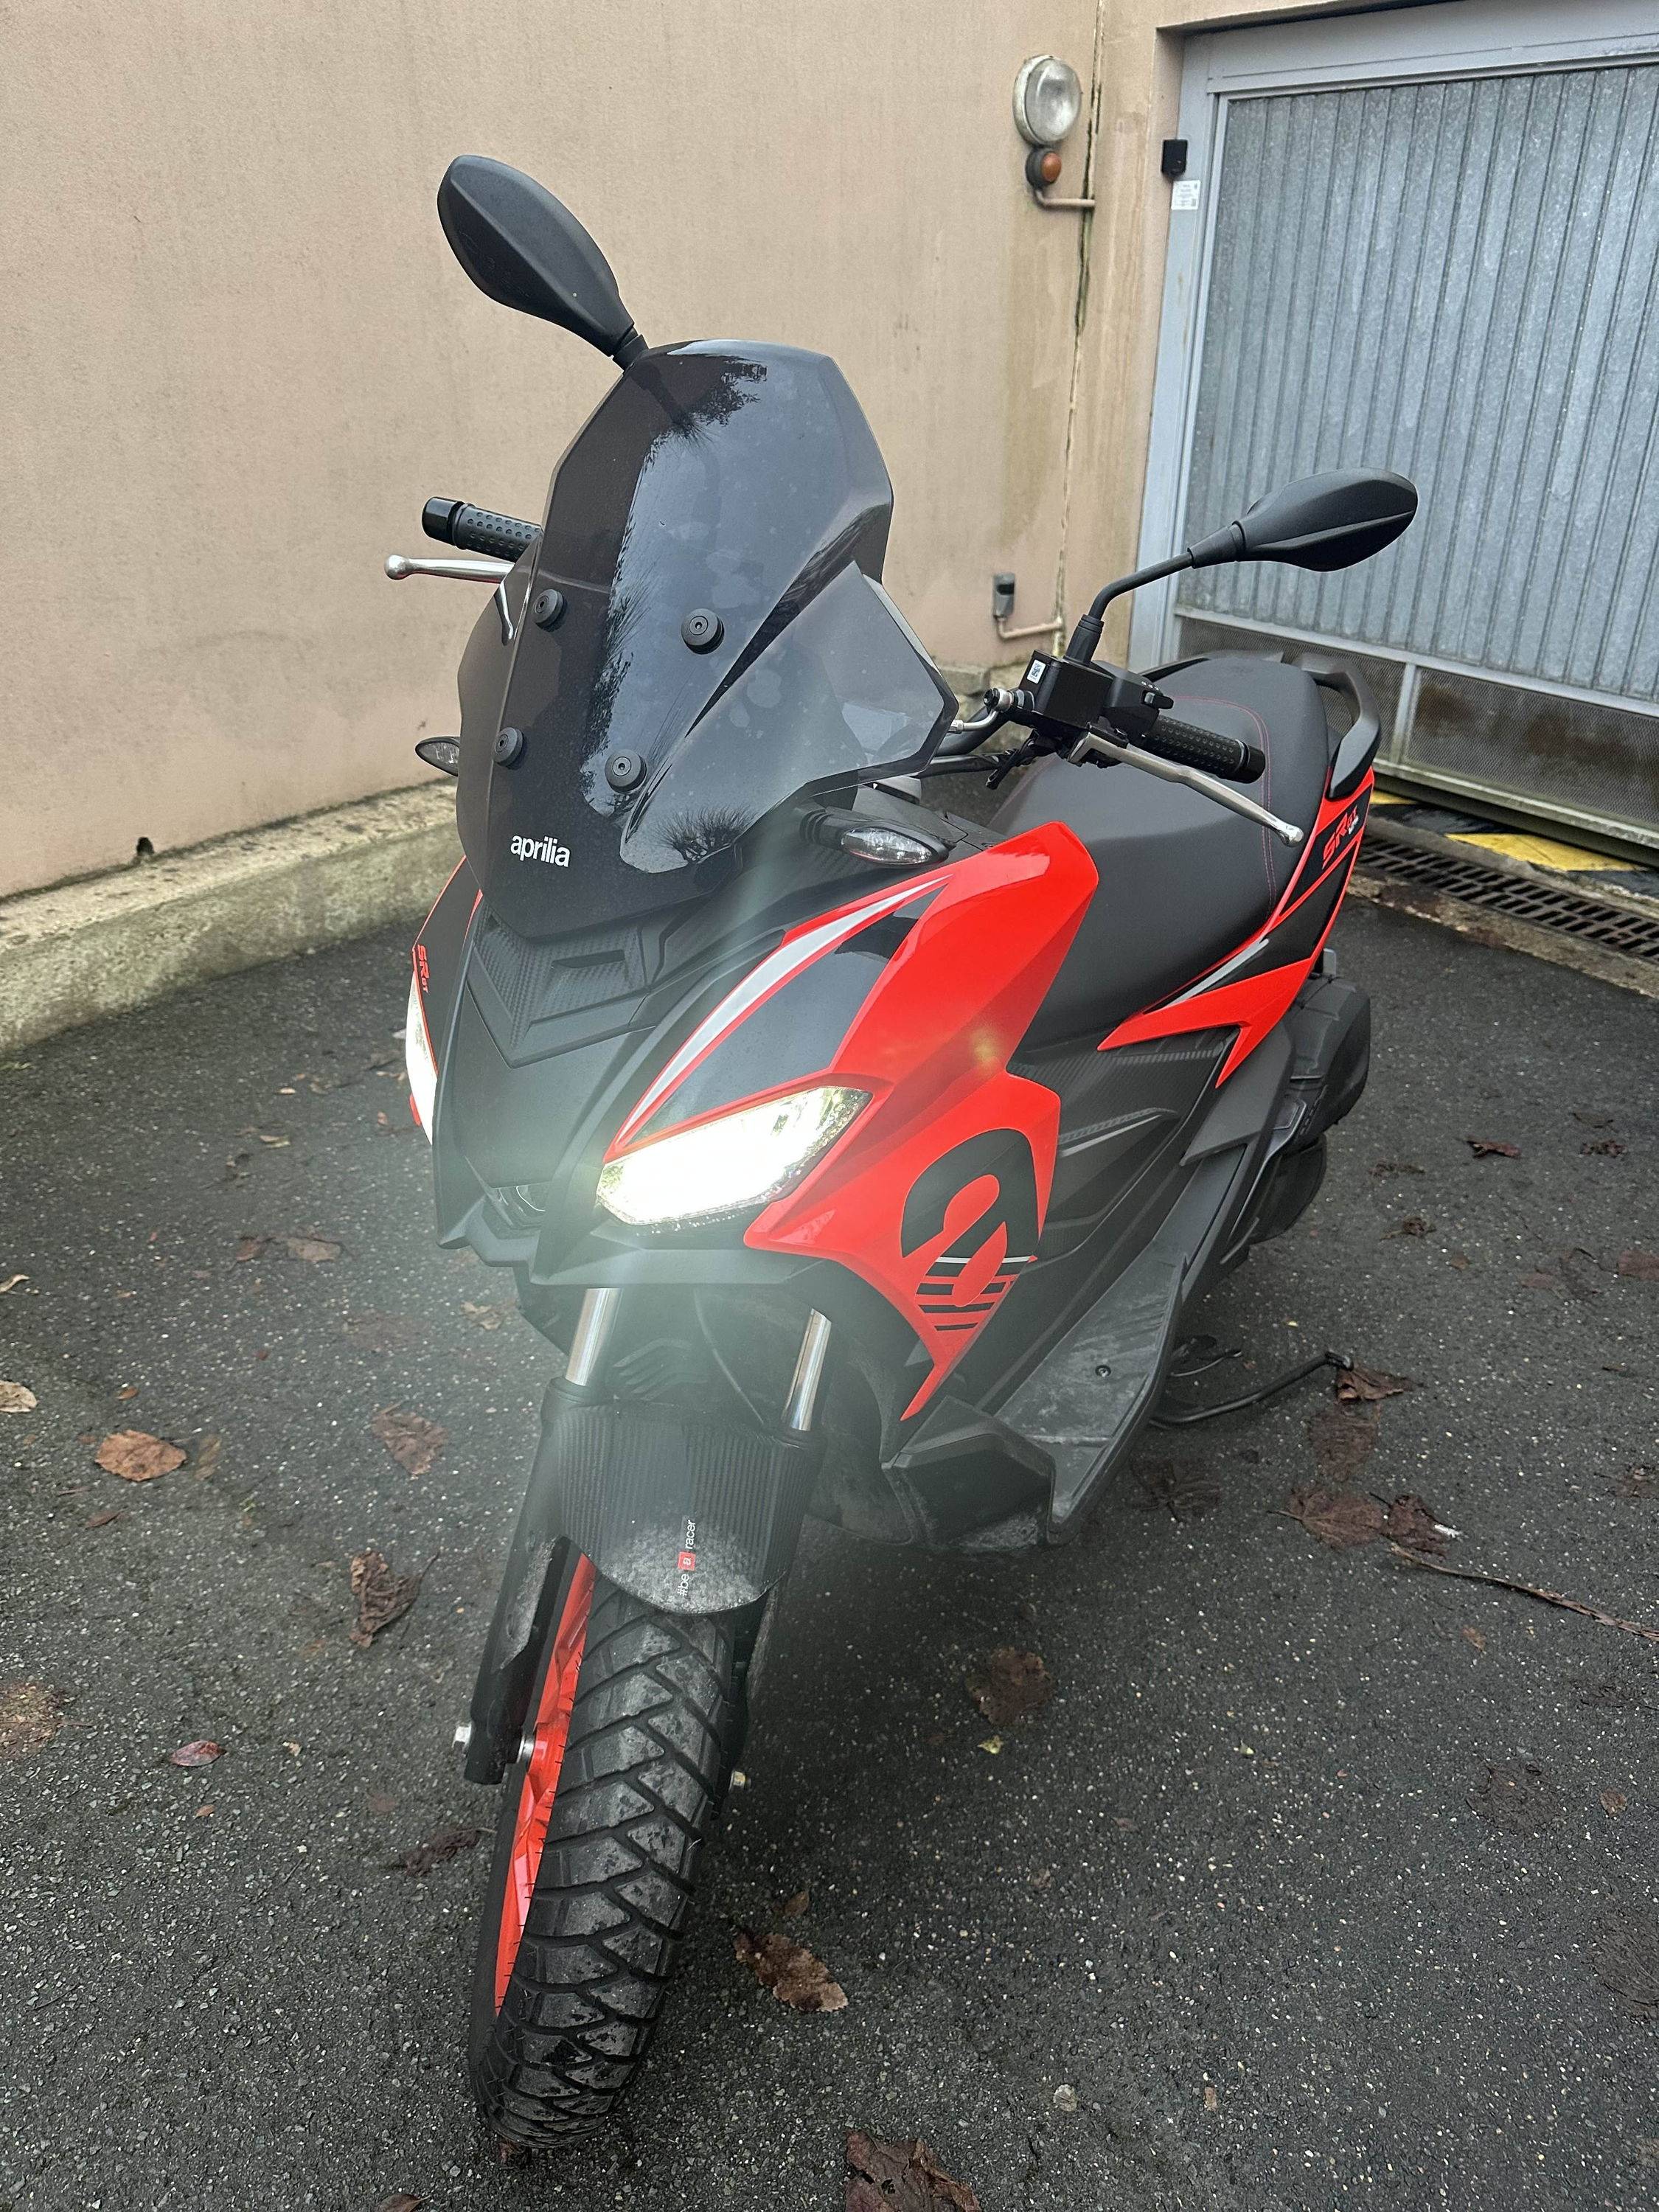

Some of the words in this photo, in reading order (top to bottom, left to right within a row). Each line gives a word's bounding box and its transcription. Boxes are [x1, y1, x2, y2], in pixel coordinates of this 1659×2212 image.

[510, 835, 571, 867] aprilia
[417, 945, 429, 978] SR
[677, 1573, 689, 1596] #be
[685, 1519, 696, 1549] racer
